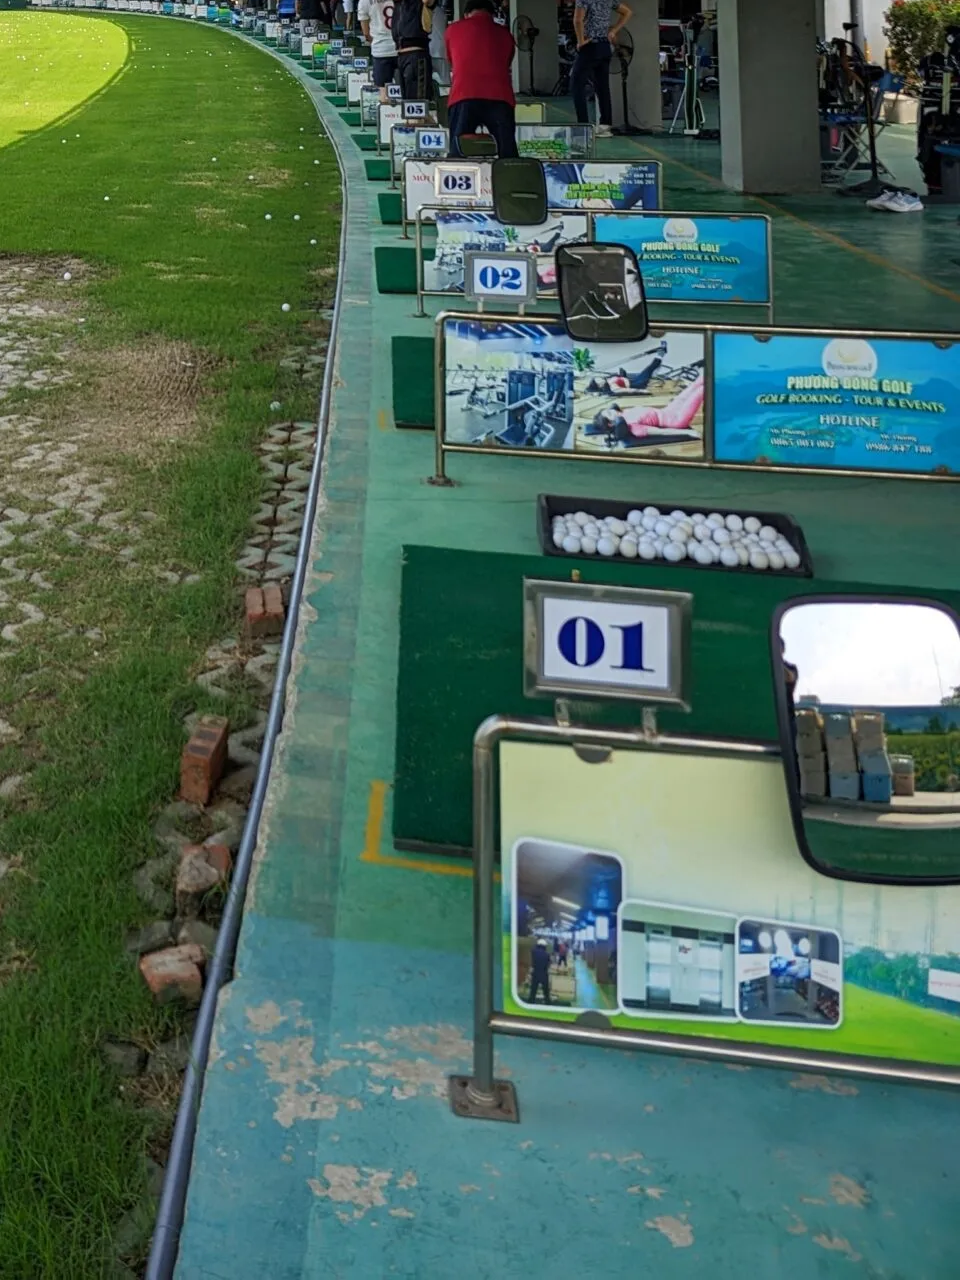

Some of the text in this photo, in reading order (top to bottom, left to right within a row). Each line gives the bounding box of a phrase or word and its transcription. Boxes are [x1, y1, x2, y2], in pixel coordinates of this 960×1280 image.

[406, 105, 423, 115] 05
[421, 134, 442, 146] 04
[443, 174, 472, 190] 03
[701, 243, 720, 253] GOLF
[642, 252, 676, 260] BOOKING
[711, 255, 740, 264] EVENTS
[479, 265, 522, 290] 02
[662, 266, 700, 275] HOTLINE
[881, 380, 913, 396] GOLF
[756, 393, 786, 404] GOLF
[788, 393, 842, 405] BOOKING
[853, 395, 884, 407] TOUR
[887, 398, 898, 408] &
[899, 398, 946, 413] EVENTS
[820, 414, 880, 428] HOTLINE
[557, 616, 655, 673] 01
